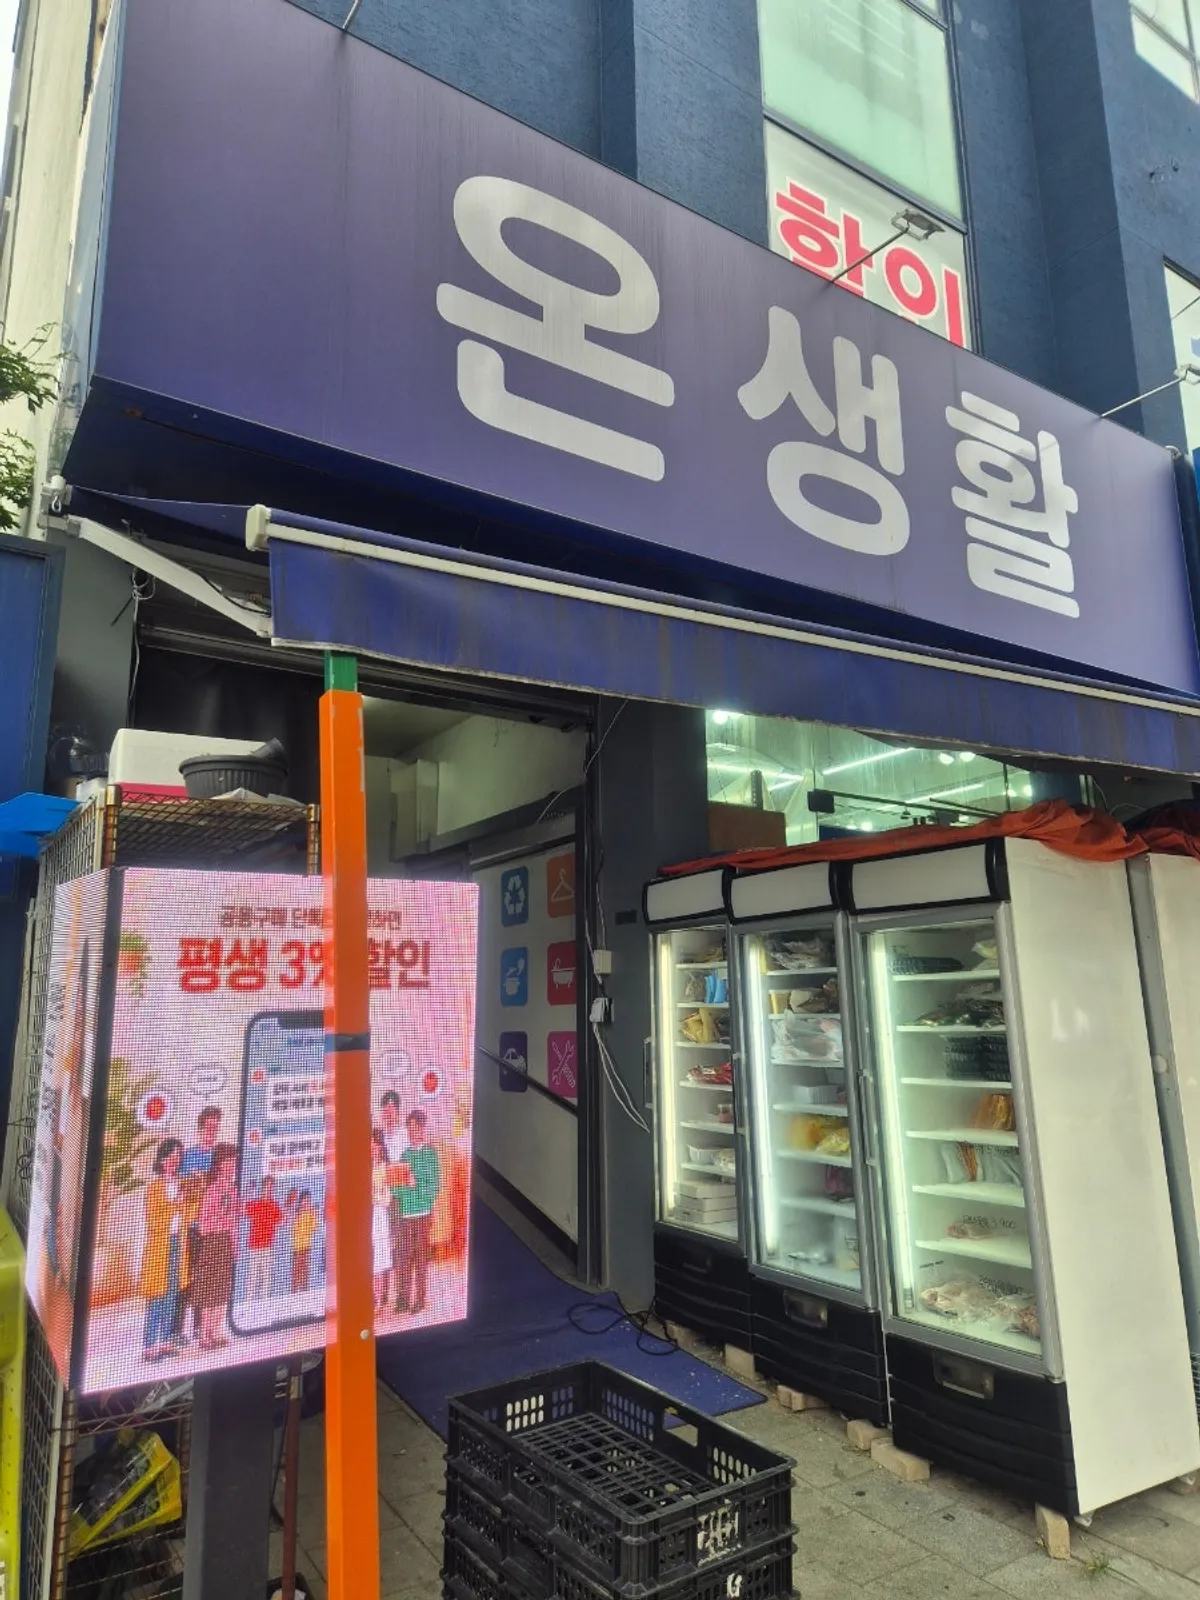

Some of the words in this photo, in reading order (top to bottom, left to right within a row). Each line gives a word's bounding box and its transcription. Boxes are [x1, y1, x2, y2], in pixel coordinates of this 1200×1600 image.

[436, 176, 1079, 619] 온생활
[219, 905, 287, 928] 공동구매
[177, 937, 268, 993] 평생
[367, 937, 431, 990] 할인
